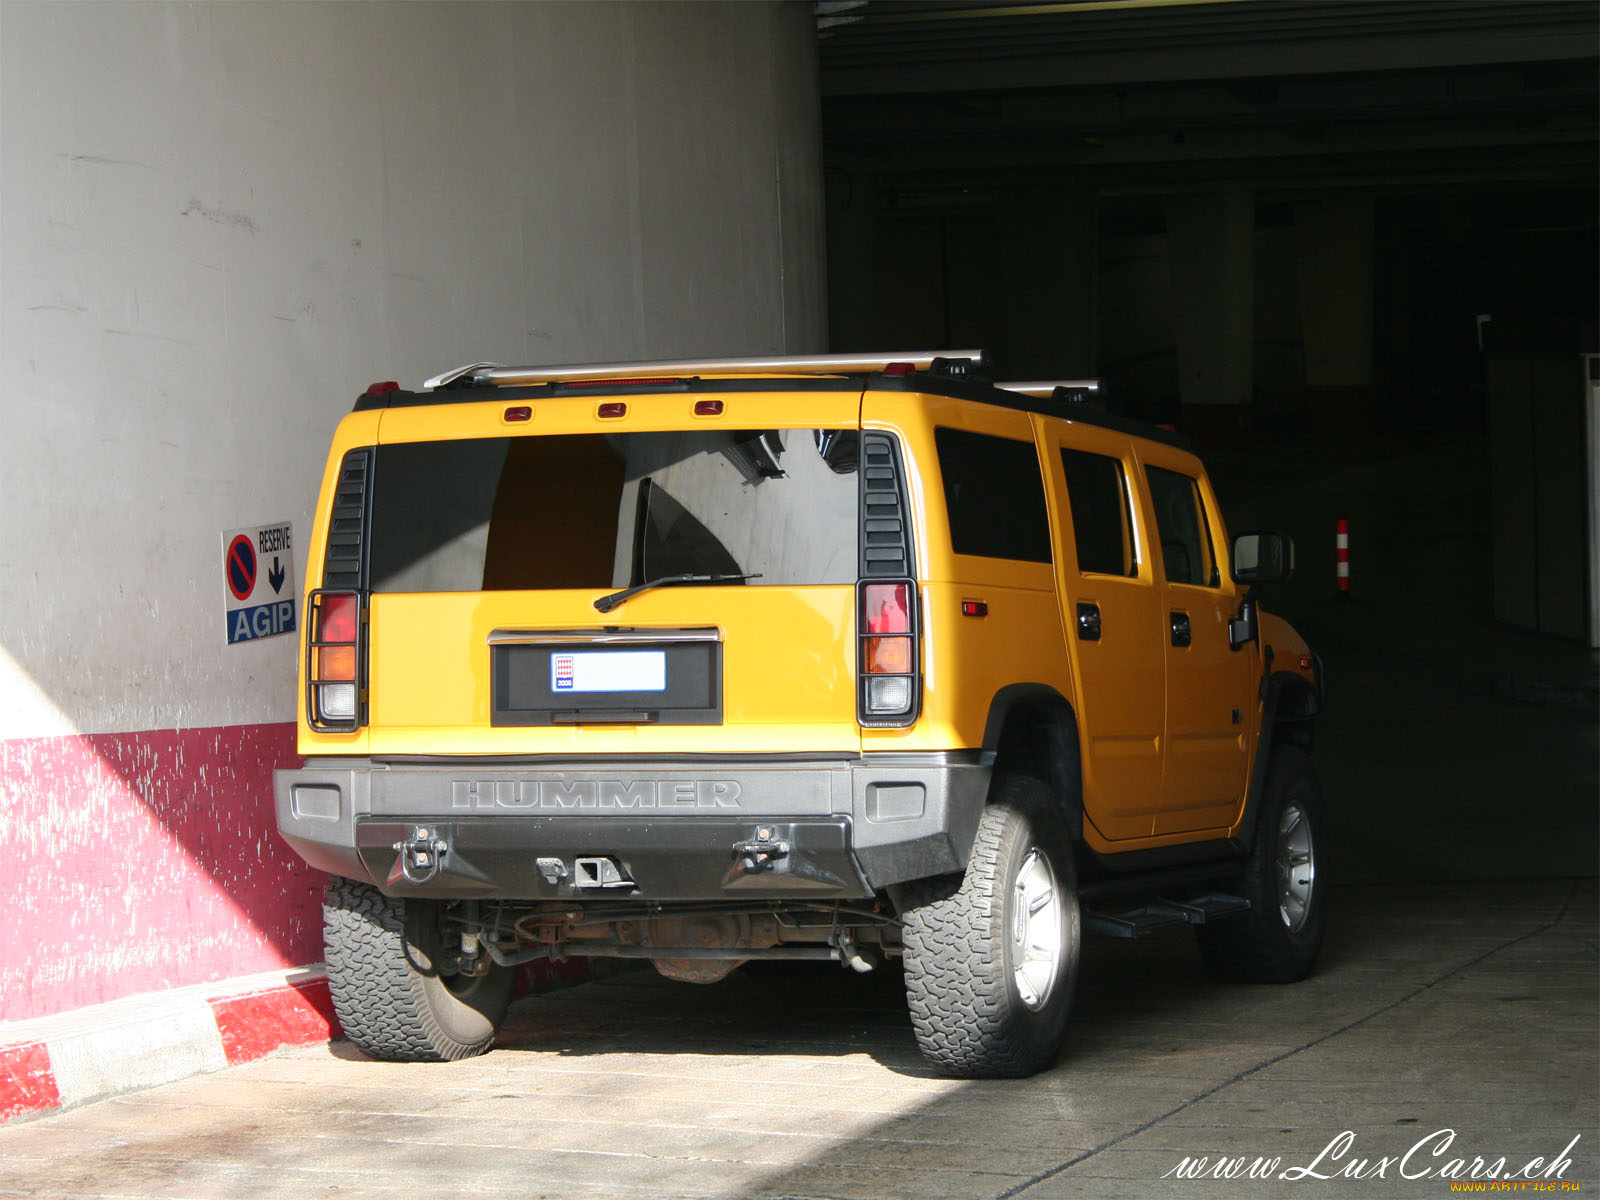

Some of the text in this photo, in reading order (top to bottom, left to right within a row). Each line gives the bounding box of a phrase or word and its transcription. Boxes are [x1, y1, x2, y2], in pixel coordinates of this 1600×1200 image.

[259, 527, 291, 553] RESERVE
[233, 602, 293, 641] AGIP
[452, 780, 741, 808] HUMMER
